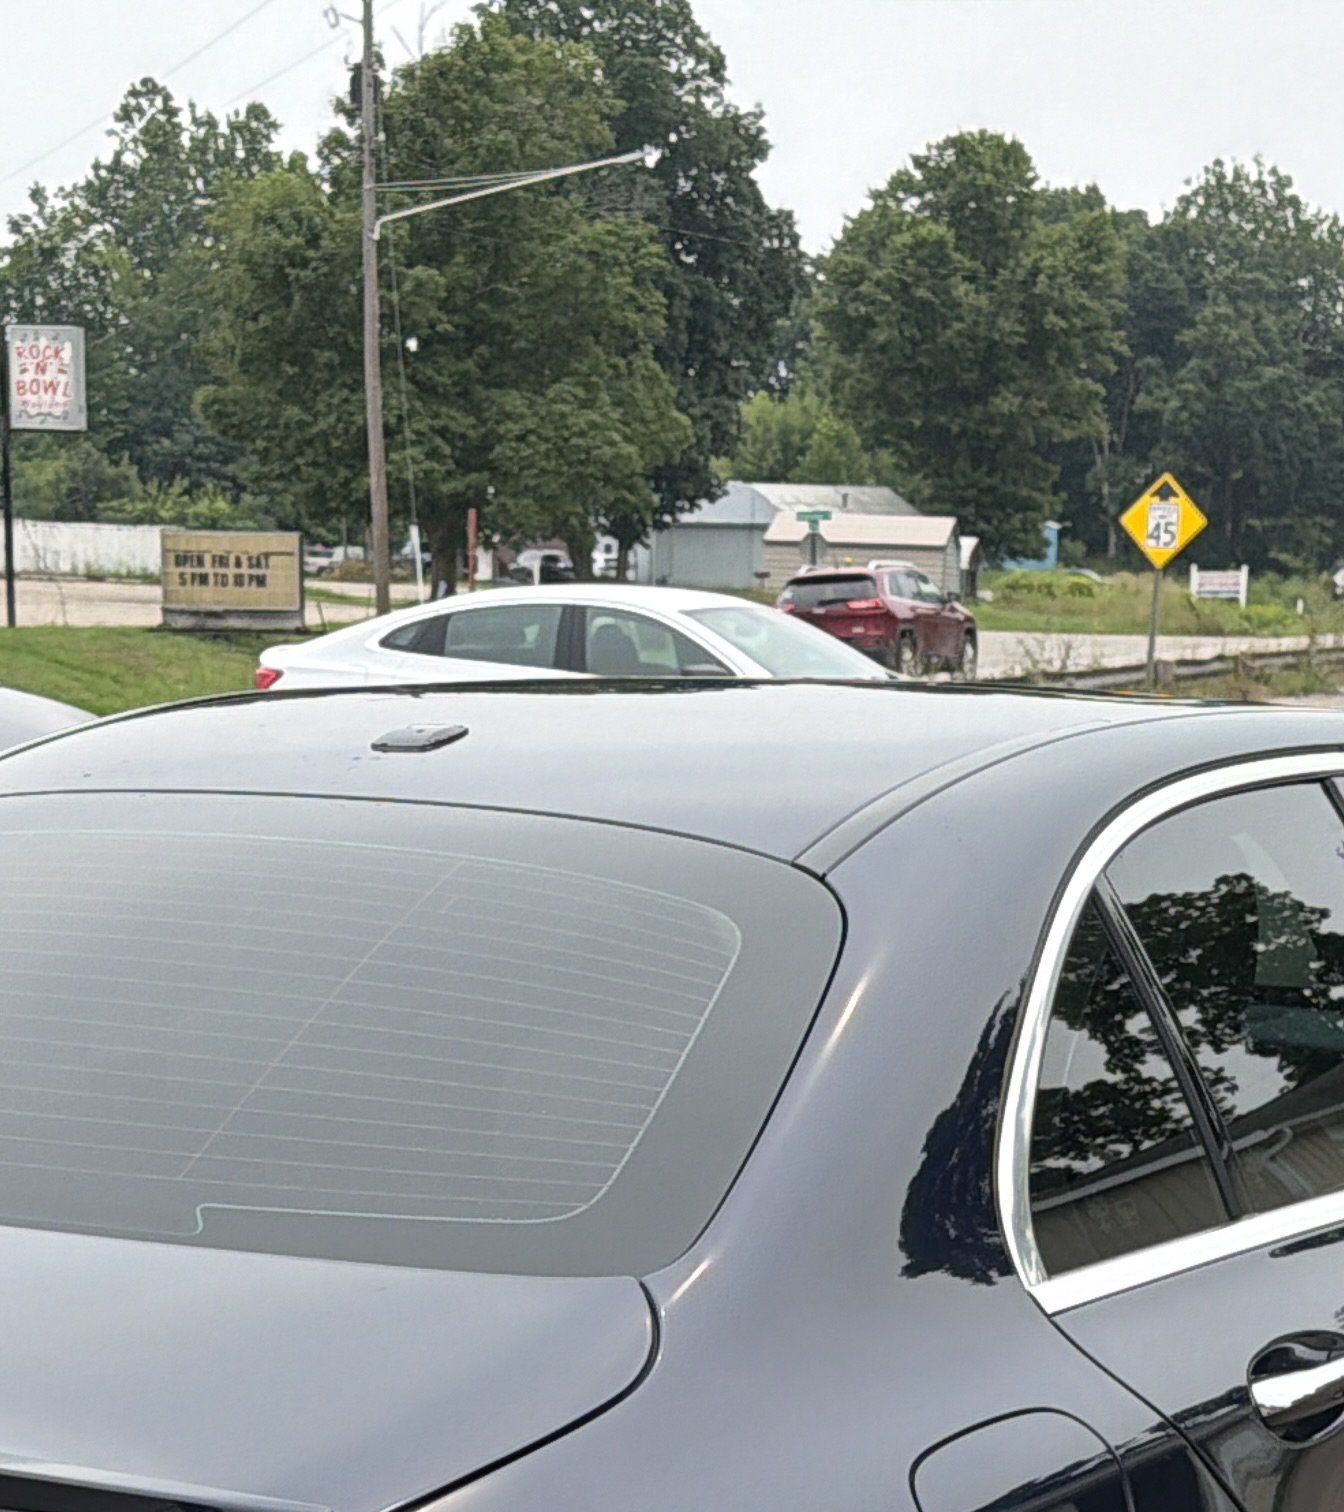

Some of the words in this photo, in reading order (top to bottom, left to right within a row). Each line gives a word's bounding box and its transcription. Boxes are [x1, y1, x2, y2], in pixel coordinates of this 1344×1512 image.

[14, 343, 65, 359] ROCK
[15, 378, 72, 397] BOWL
[1146, 521, 1176, 547] 45
[174, 553, 205, 568] OPEN
[178, 572, 188, 587] 5
[190, 572, 209, 587] PM
[213, 573, 229, 588] TO
